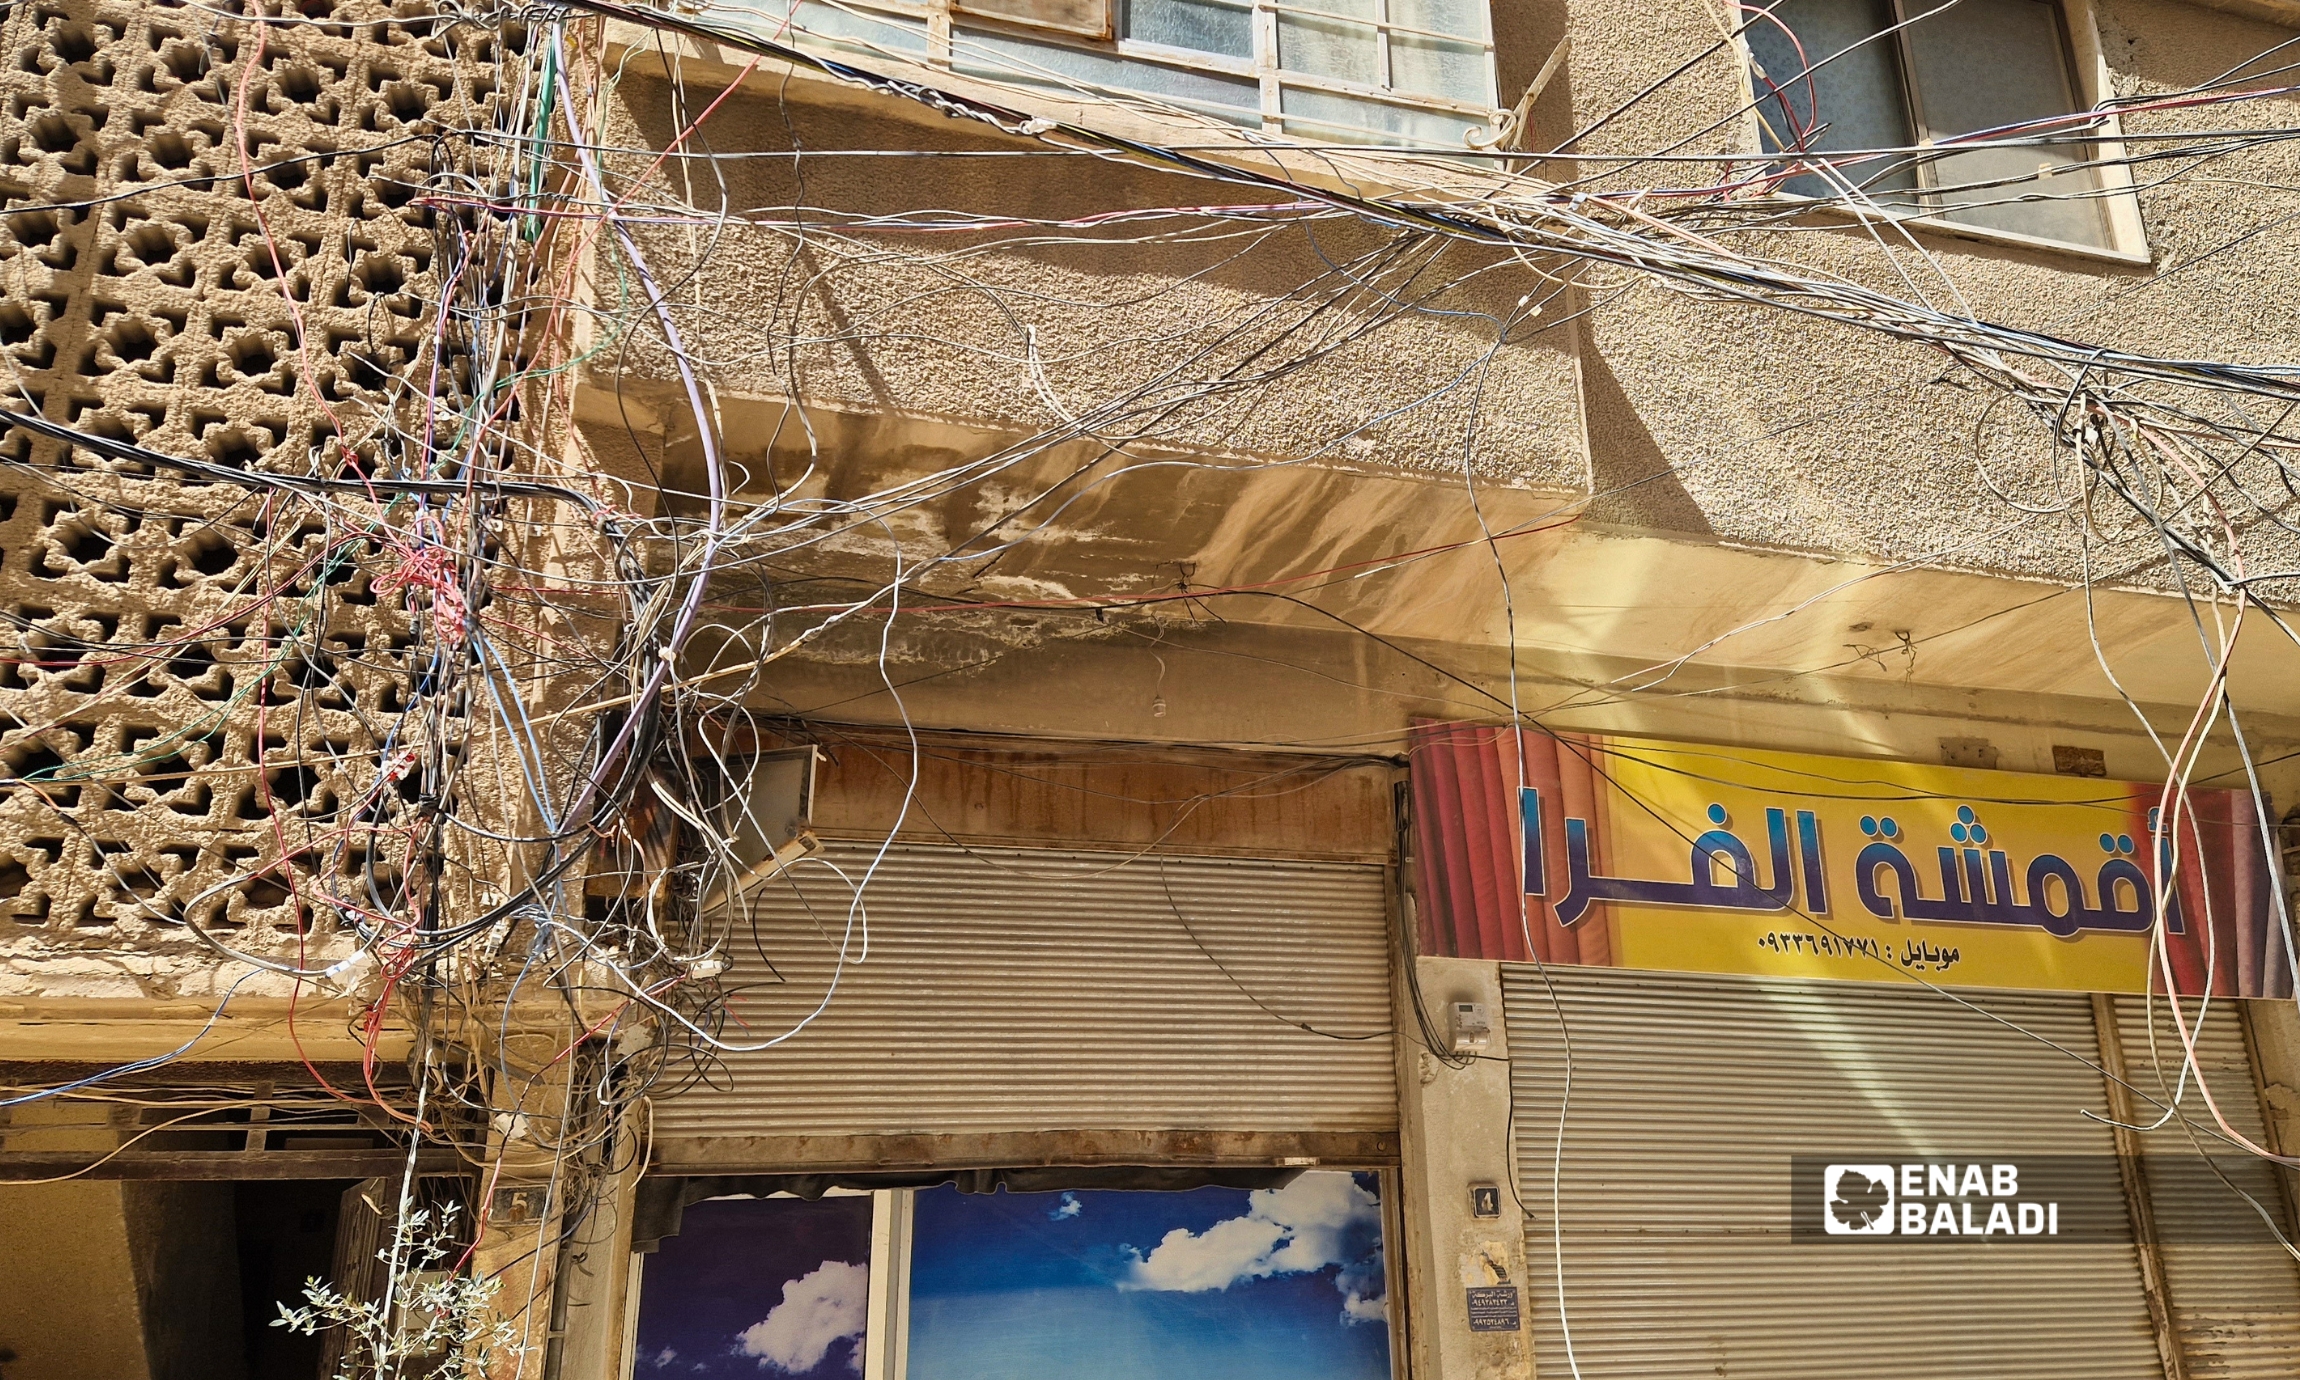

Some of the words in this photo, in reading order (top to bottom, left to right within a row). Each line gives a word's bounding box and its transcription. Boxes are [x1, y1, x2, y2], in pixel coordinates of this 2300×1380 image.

[1517, 786, 1828, 927] الفرا
[1854, 804, 2186, 937] أقمشة
[1901, 938, 1960, 971] موبايل
